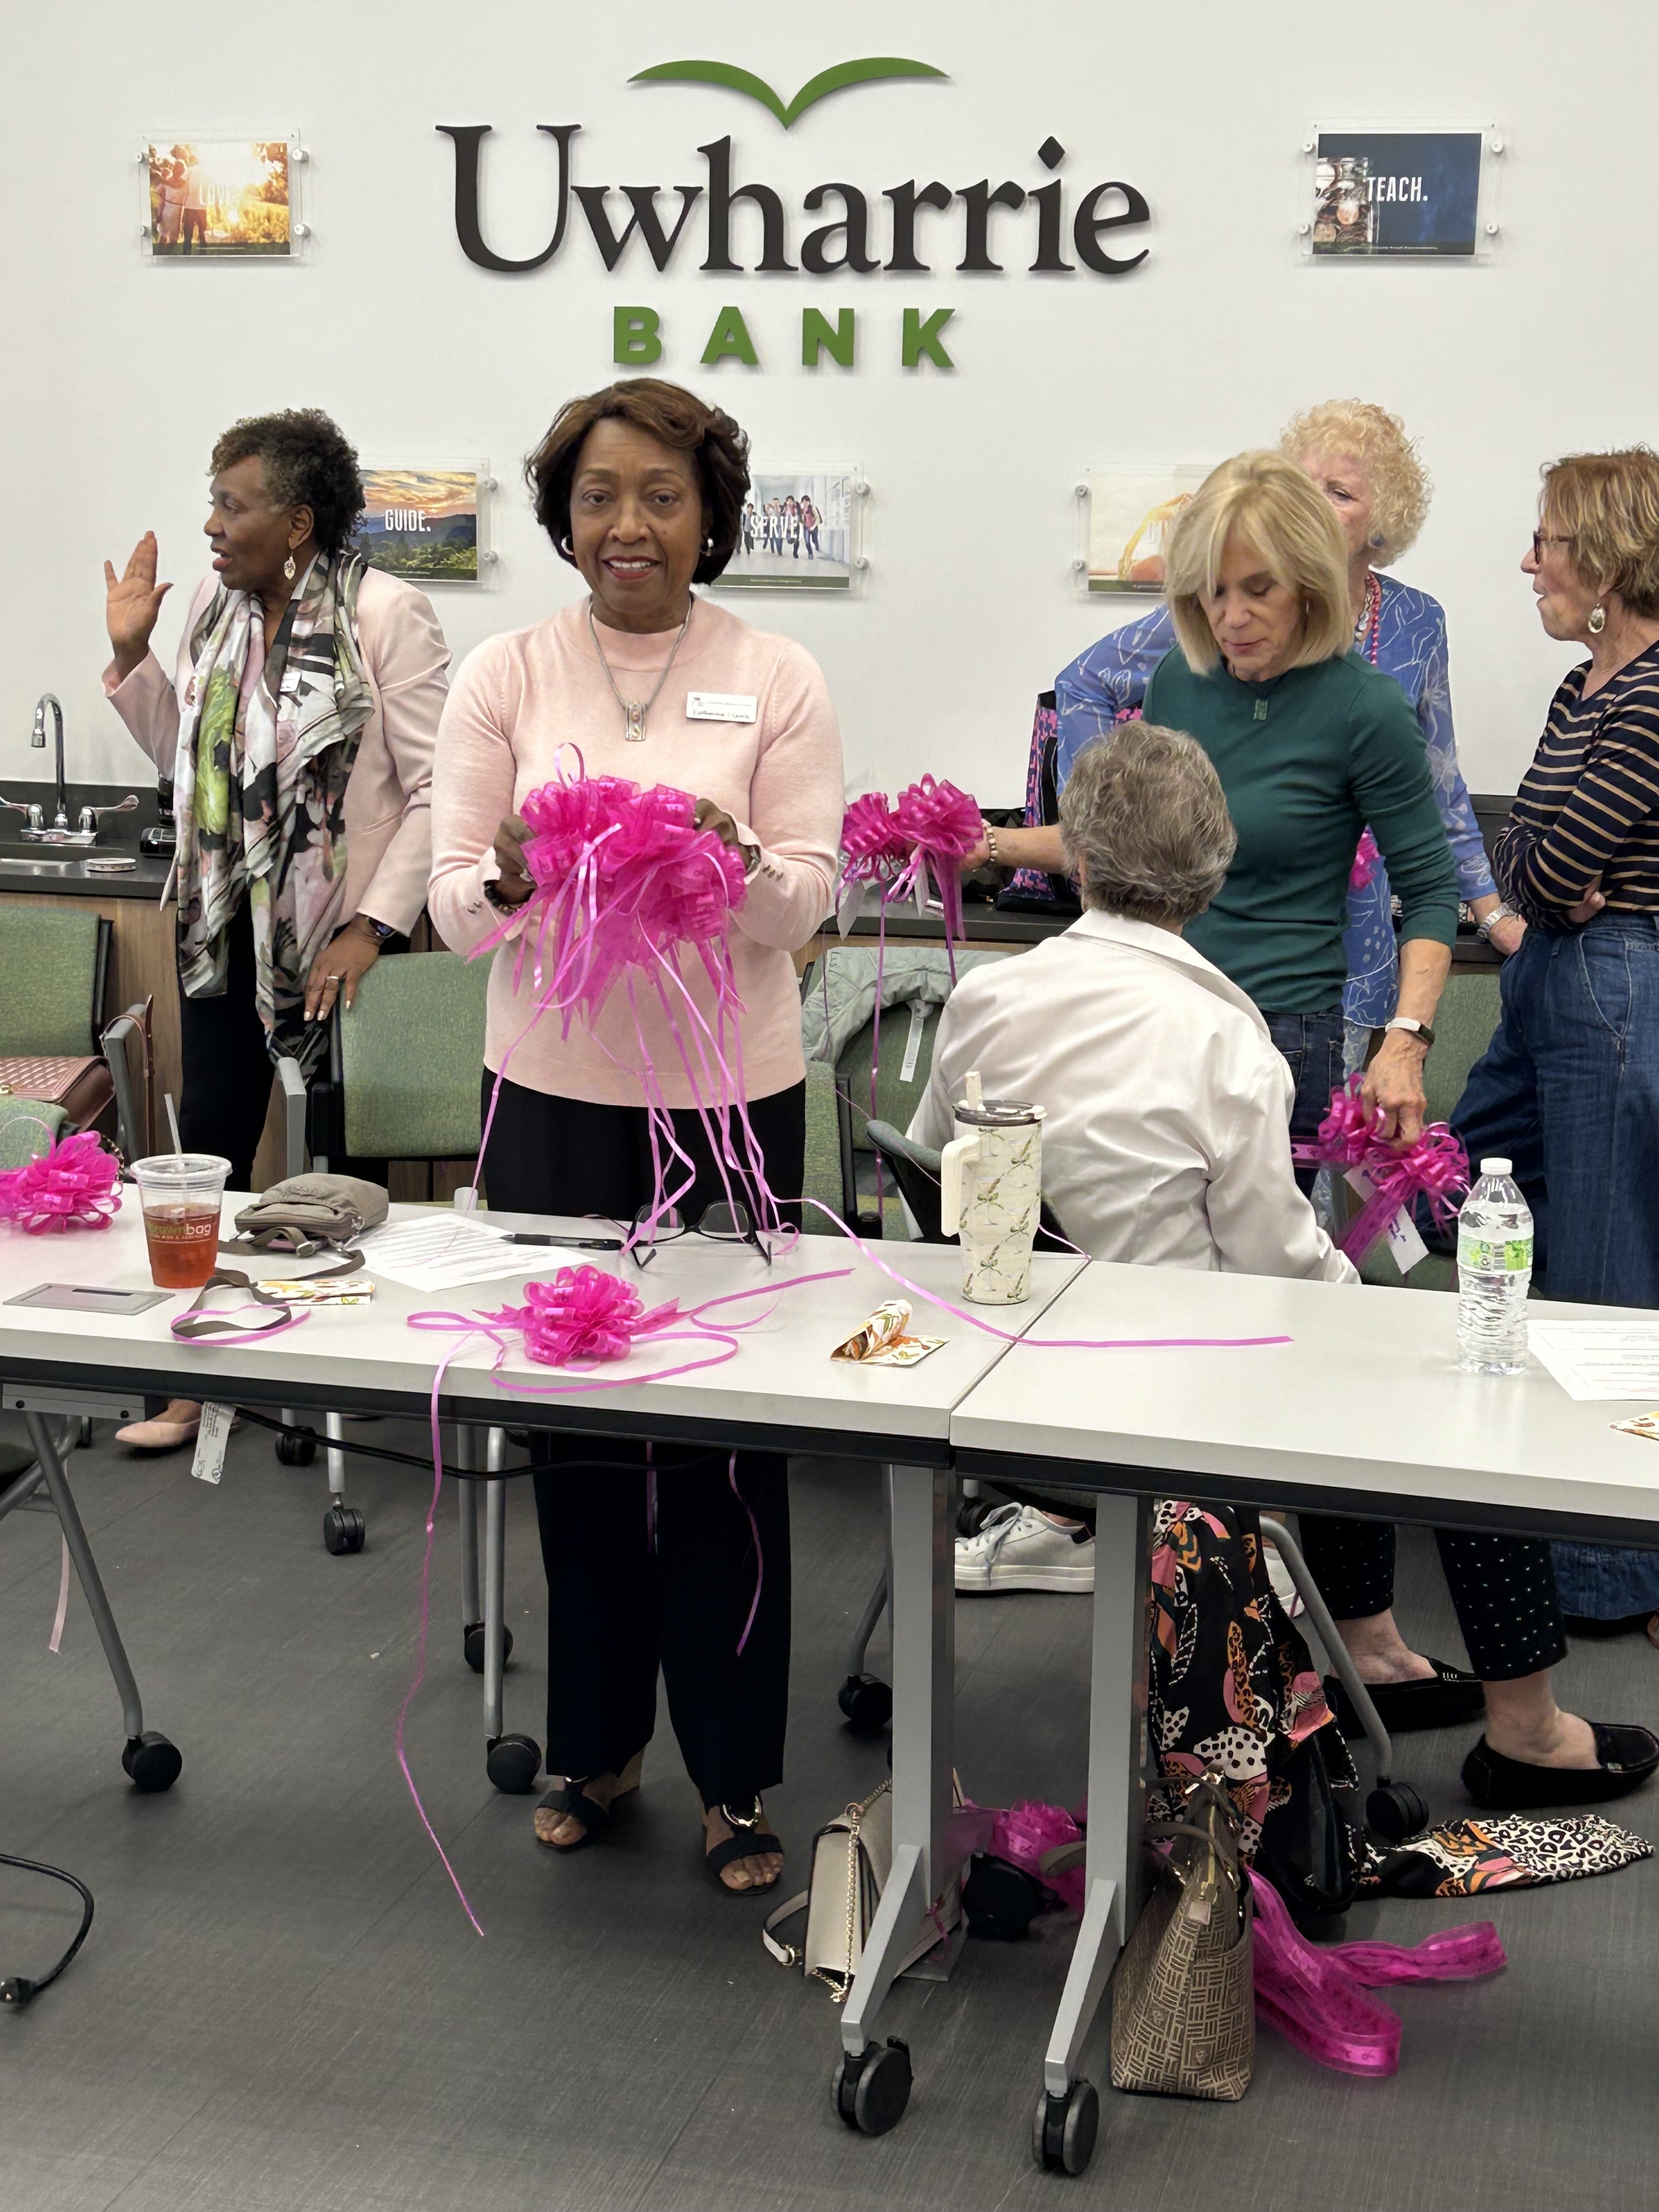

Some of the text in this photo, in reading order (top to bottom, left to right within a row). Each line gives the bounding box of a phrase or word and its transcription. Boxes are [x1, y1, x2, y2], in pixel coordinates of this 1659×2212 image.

[435, 124, 1150, 274] Uwharrie
[1367, 176, 1428, 202] TEACH.
[614, 306, 955, 367] BANK
[385, 509, 431, 532] GUIDE.
